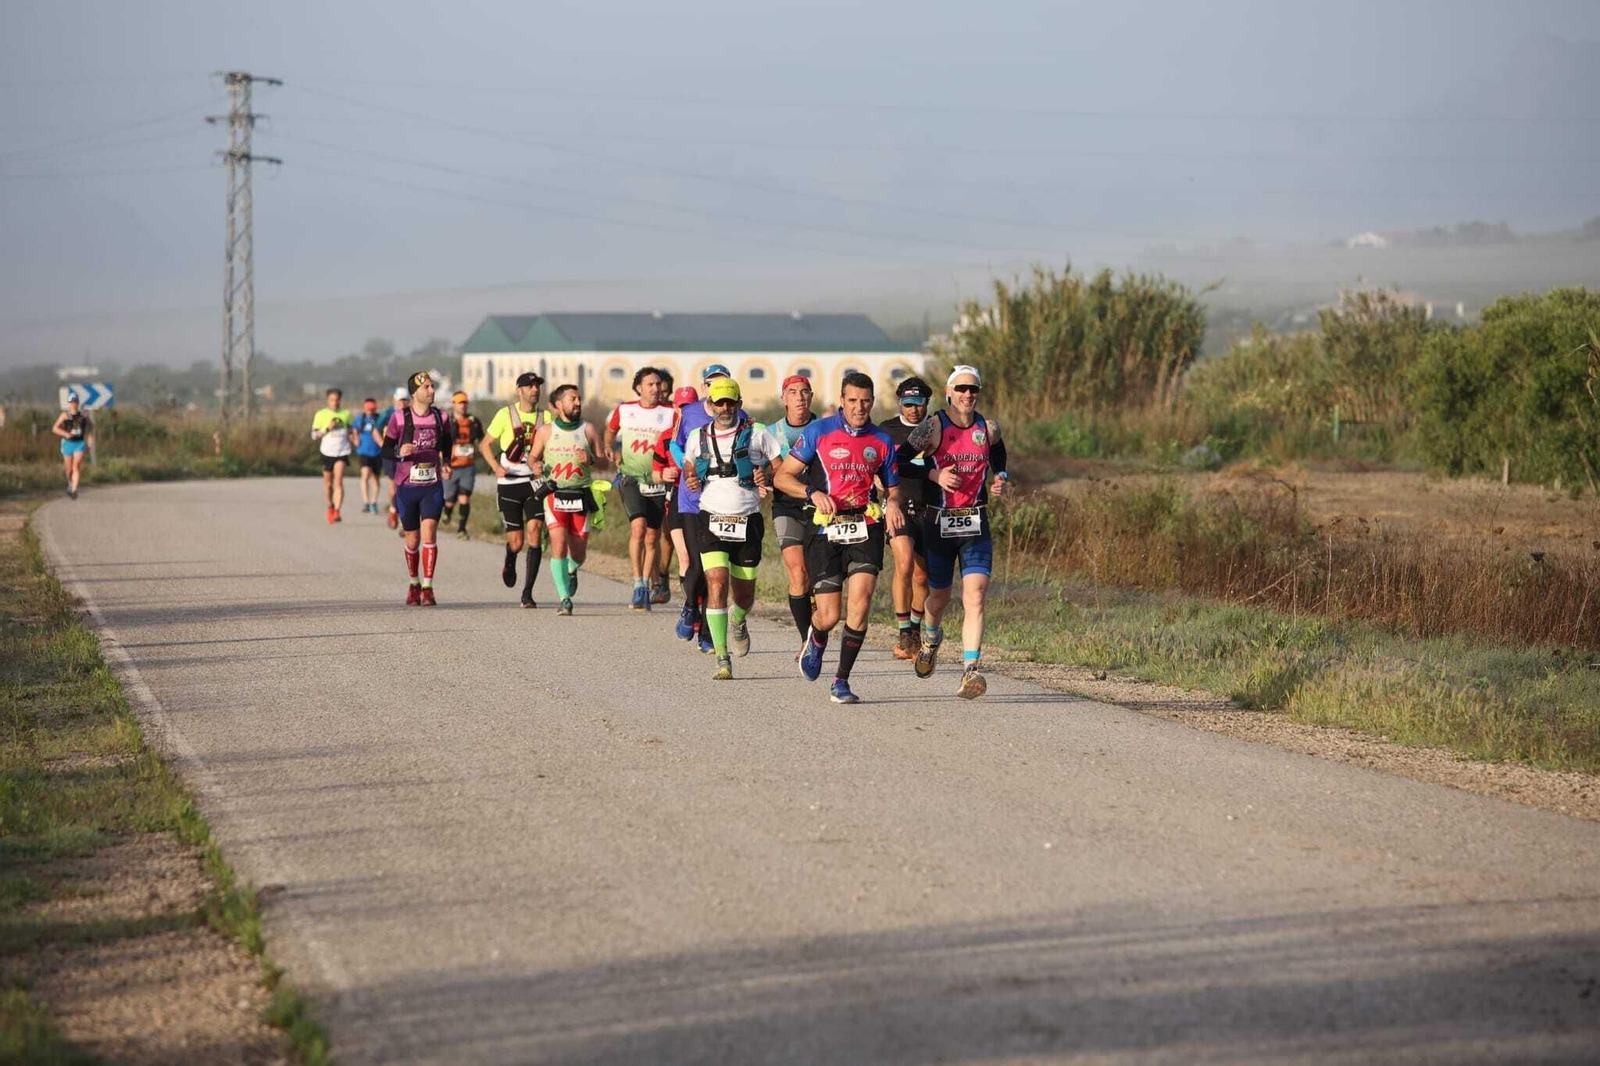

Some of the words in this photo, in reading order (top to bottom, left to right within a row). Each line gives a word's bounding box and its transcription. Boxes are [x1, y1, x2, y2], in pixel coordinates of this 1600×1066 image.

[718, 522, 736, 533] 121
[947, 516, 972, 528] 256
[834, 523, 858, 536] 179
